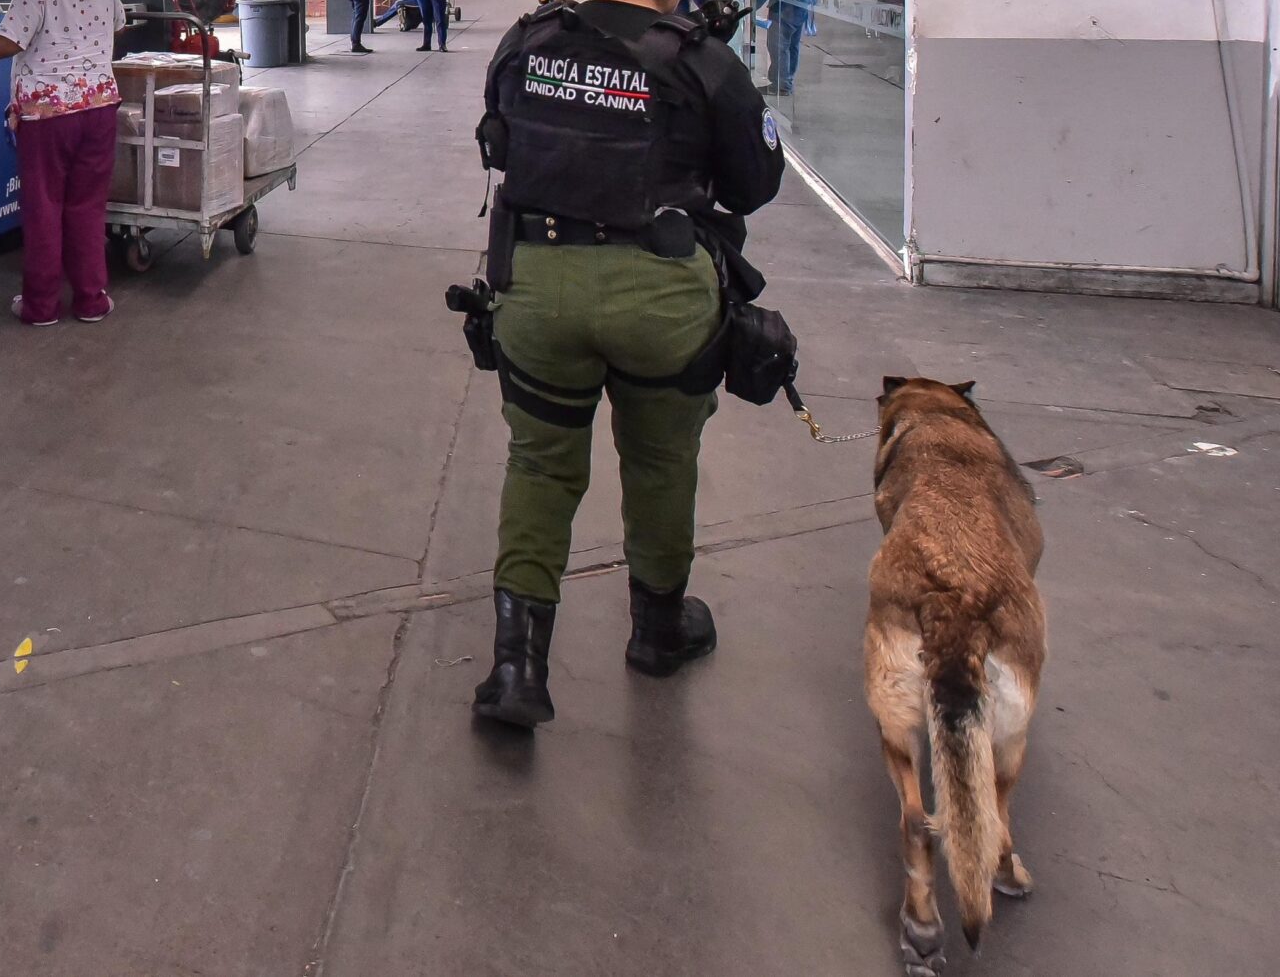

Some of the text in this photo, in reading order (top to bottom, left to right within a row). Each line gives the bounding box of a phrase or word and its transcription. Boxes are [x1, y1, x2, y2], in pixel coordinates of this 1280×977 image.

[527, 54, 649, 92] POLICÍA ESTATAL
[525, 80, 646, 112] UNIDAD CANINA
